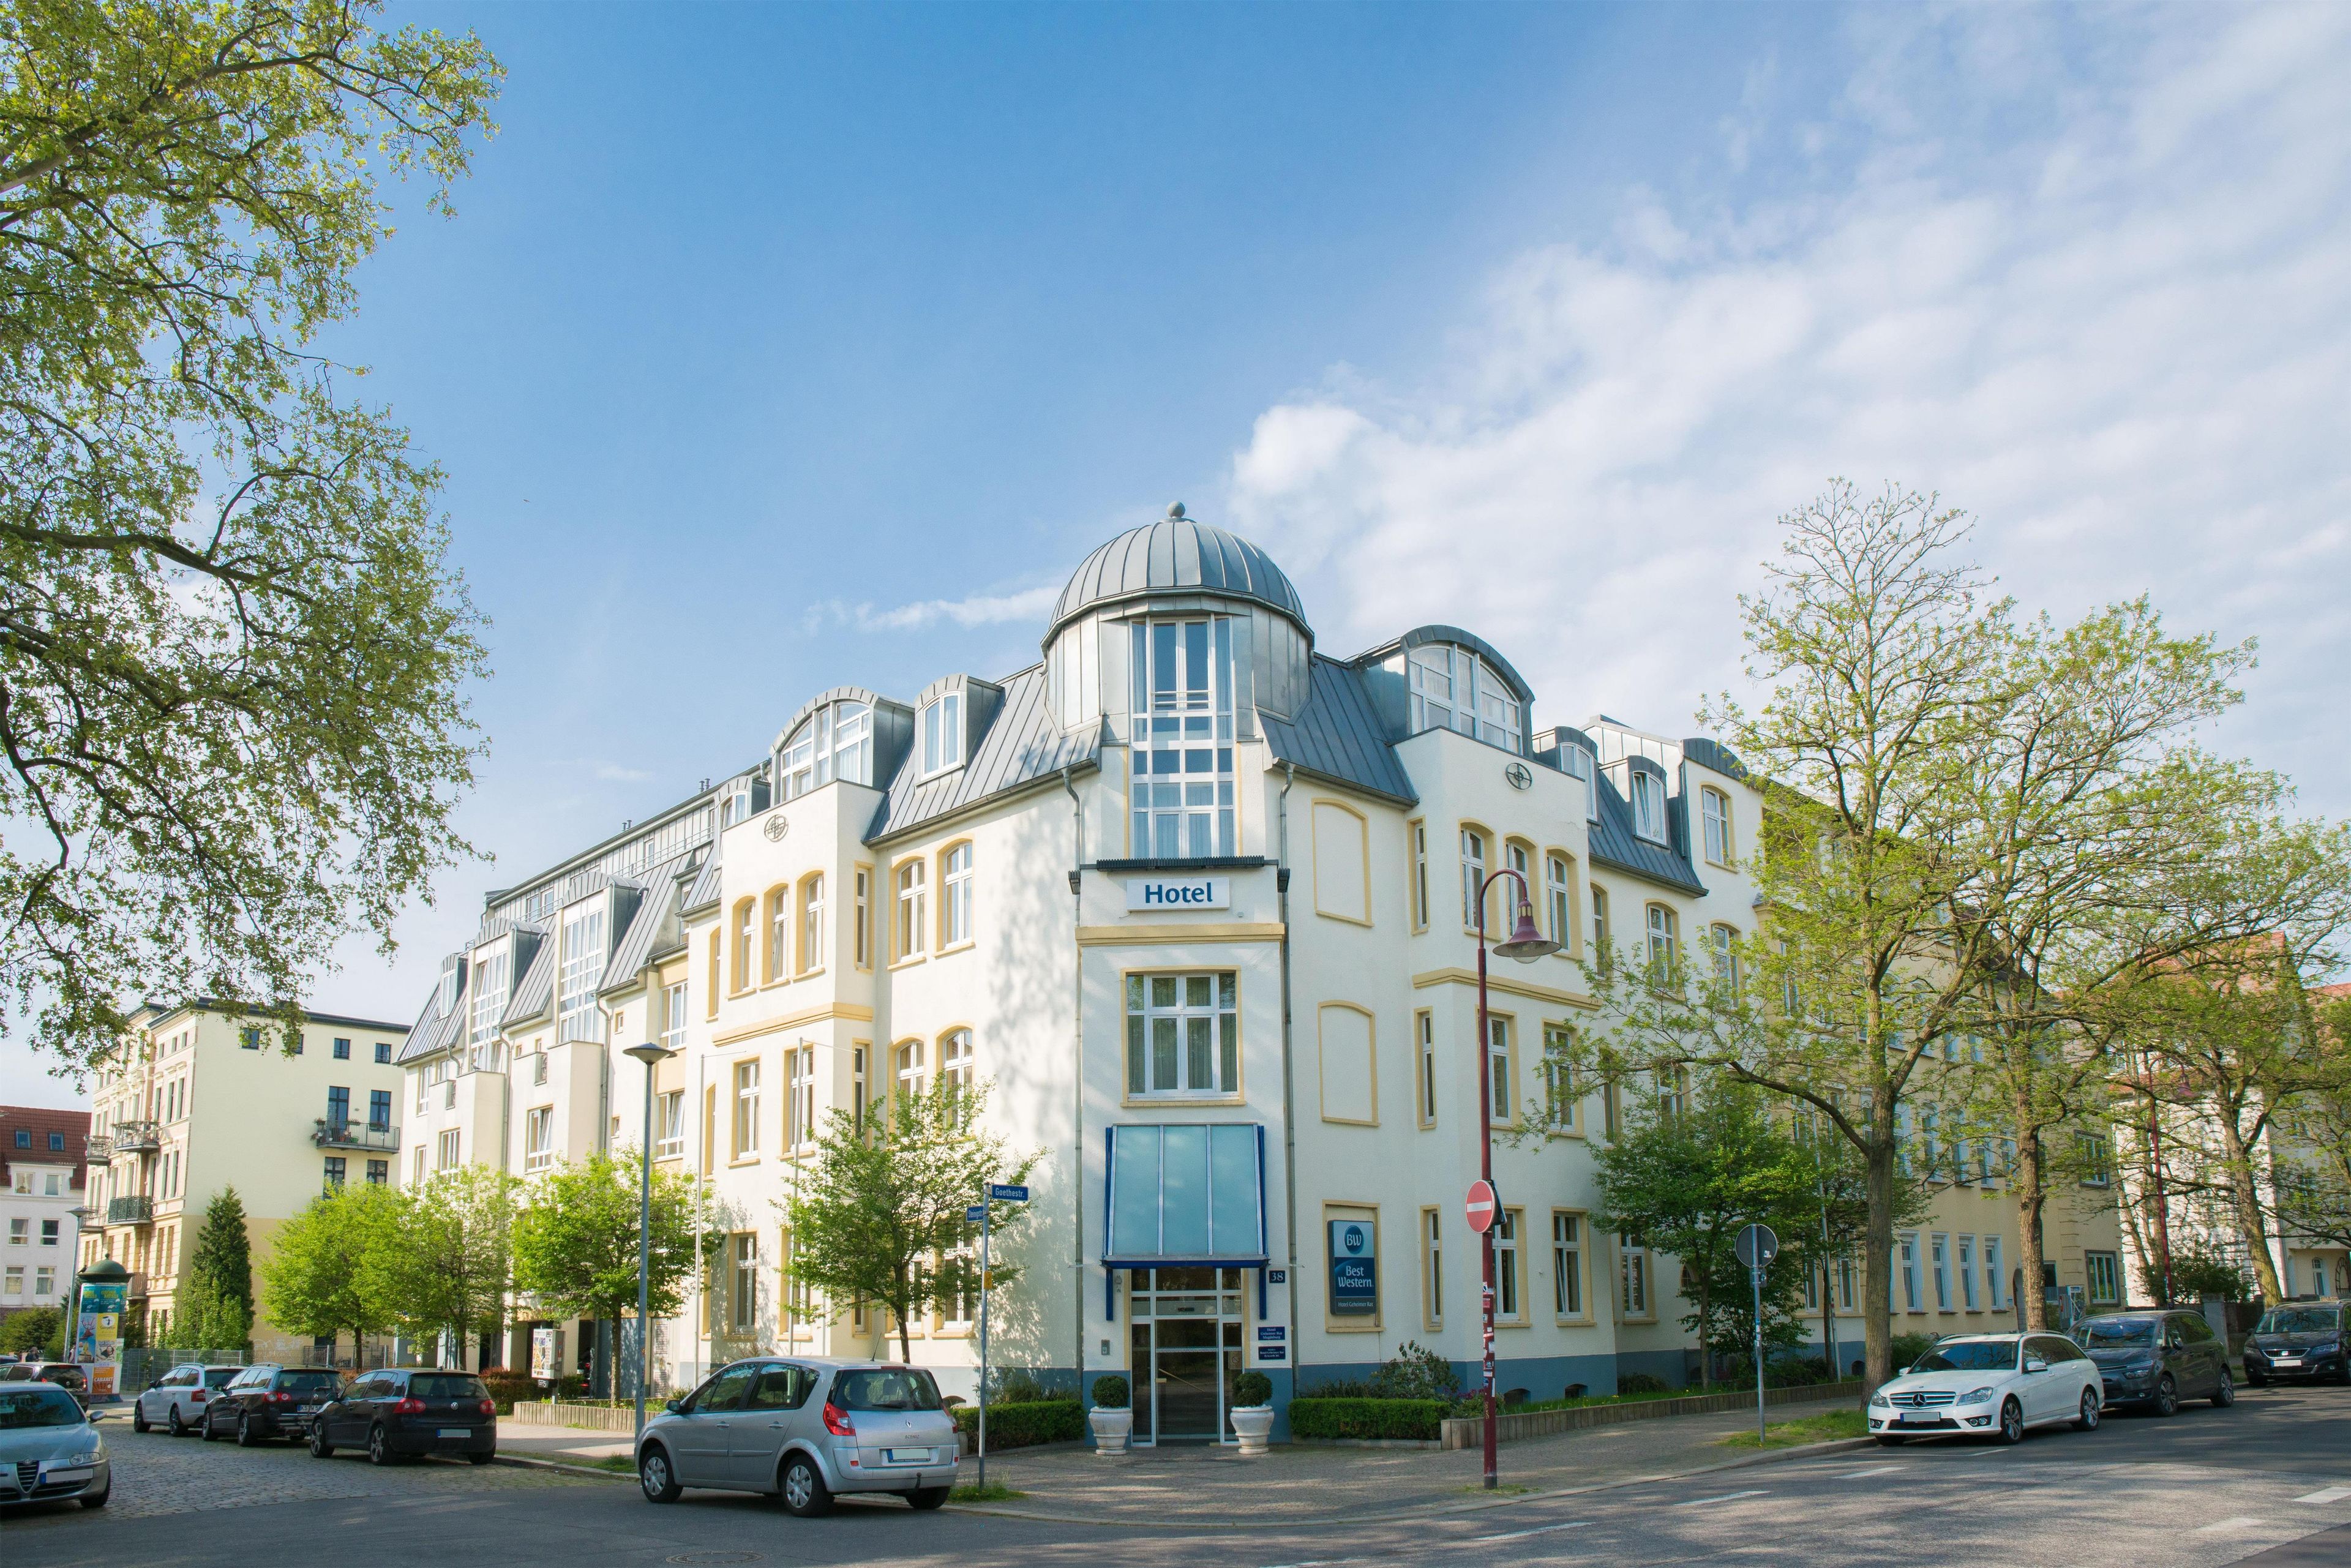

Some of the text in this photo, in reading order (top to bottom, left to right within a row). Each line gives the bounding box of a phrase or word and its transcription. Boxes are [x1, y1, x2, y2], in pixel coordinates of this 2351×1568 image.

[1145, 882, 1213, 904] Hotel
[995, 1187, 1025, 1198] Goethestr.
[1346, 1234, 1362, 1247] BW
[1271, 1272, 1284, 1281] 38
[1346, 1266, 1364, 1277] Best
[1338, 1277, 1372, 1288] Western
